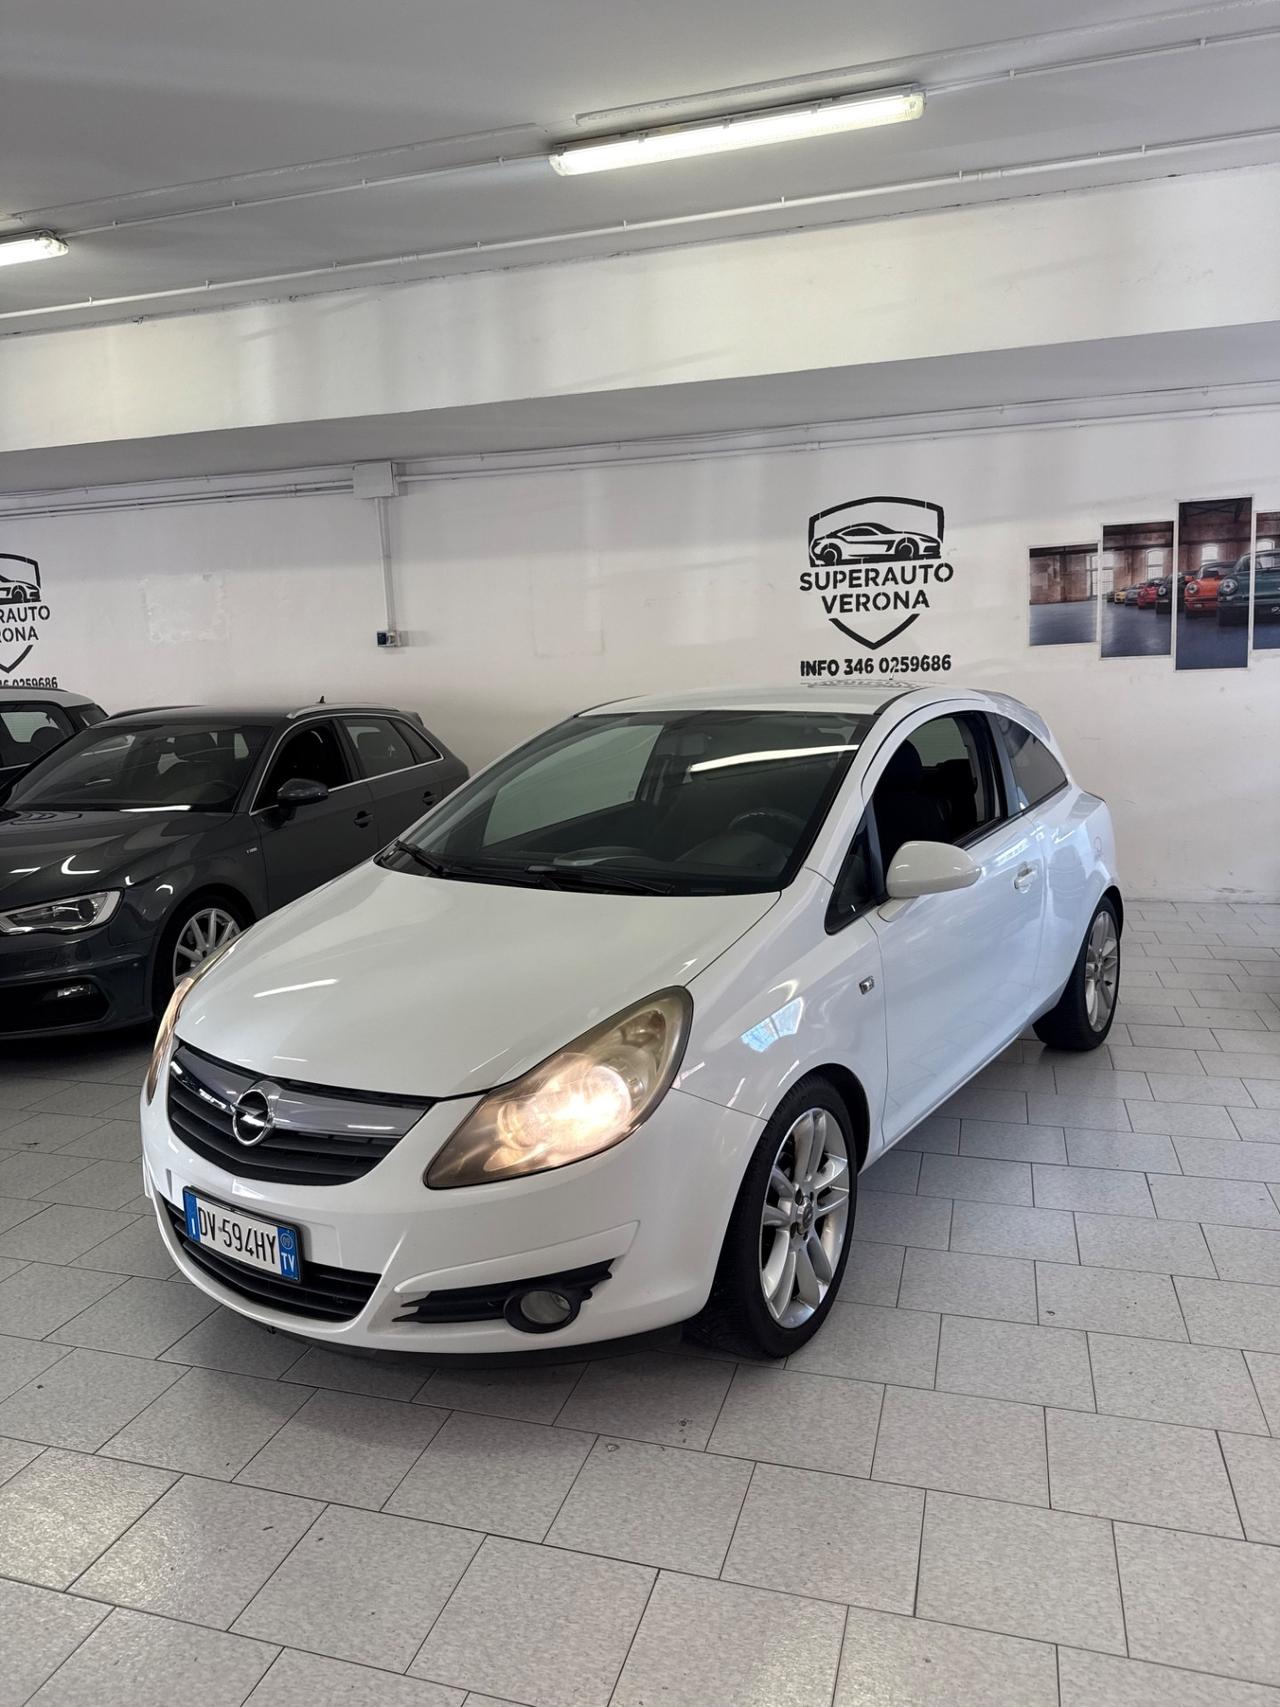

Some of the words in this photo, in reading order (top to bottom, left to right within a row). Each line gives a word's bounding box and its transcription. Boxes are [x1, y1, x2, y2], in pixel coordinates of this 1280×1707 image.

[799, 562, 954, 591] SUPERAUTO
[821, 589, 930, 614] VERONA
[0, 625, 39, 643] ONA
[800, 659, 839, 677] INFO
[843, 657, 874, 675] 346
[879, 654, 952, 674] 0259686
[198, 1206, 215, 1241] DV
[222, 1218, 276, 1265] 594HY
[281, 1251, 295, 1273] TV
